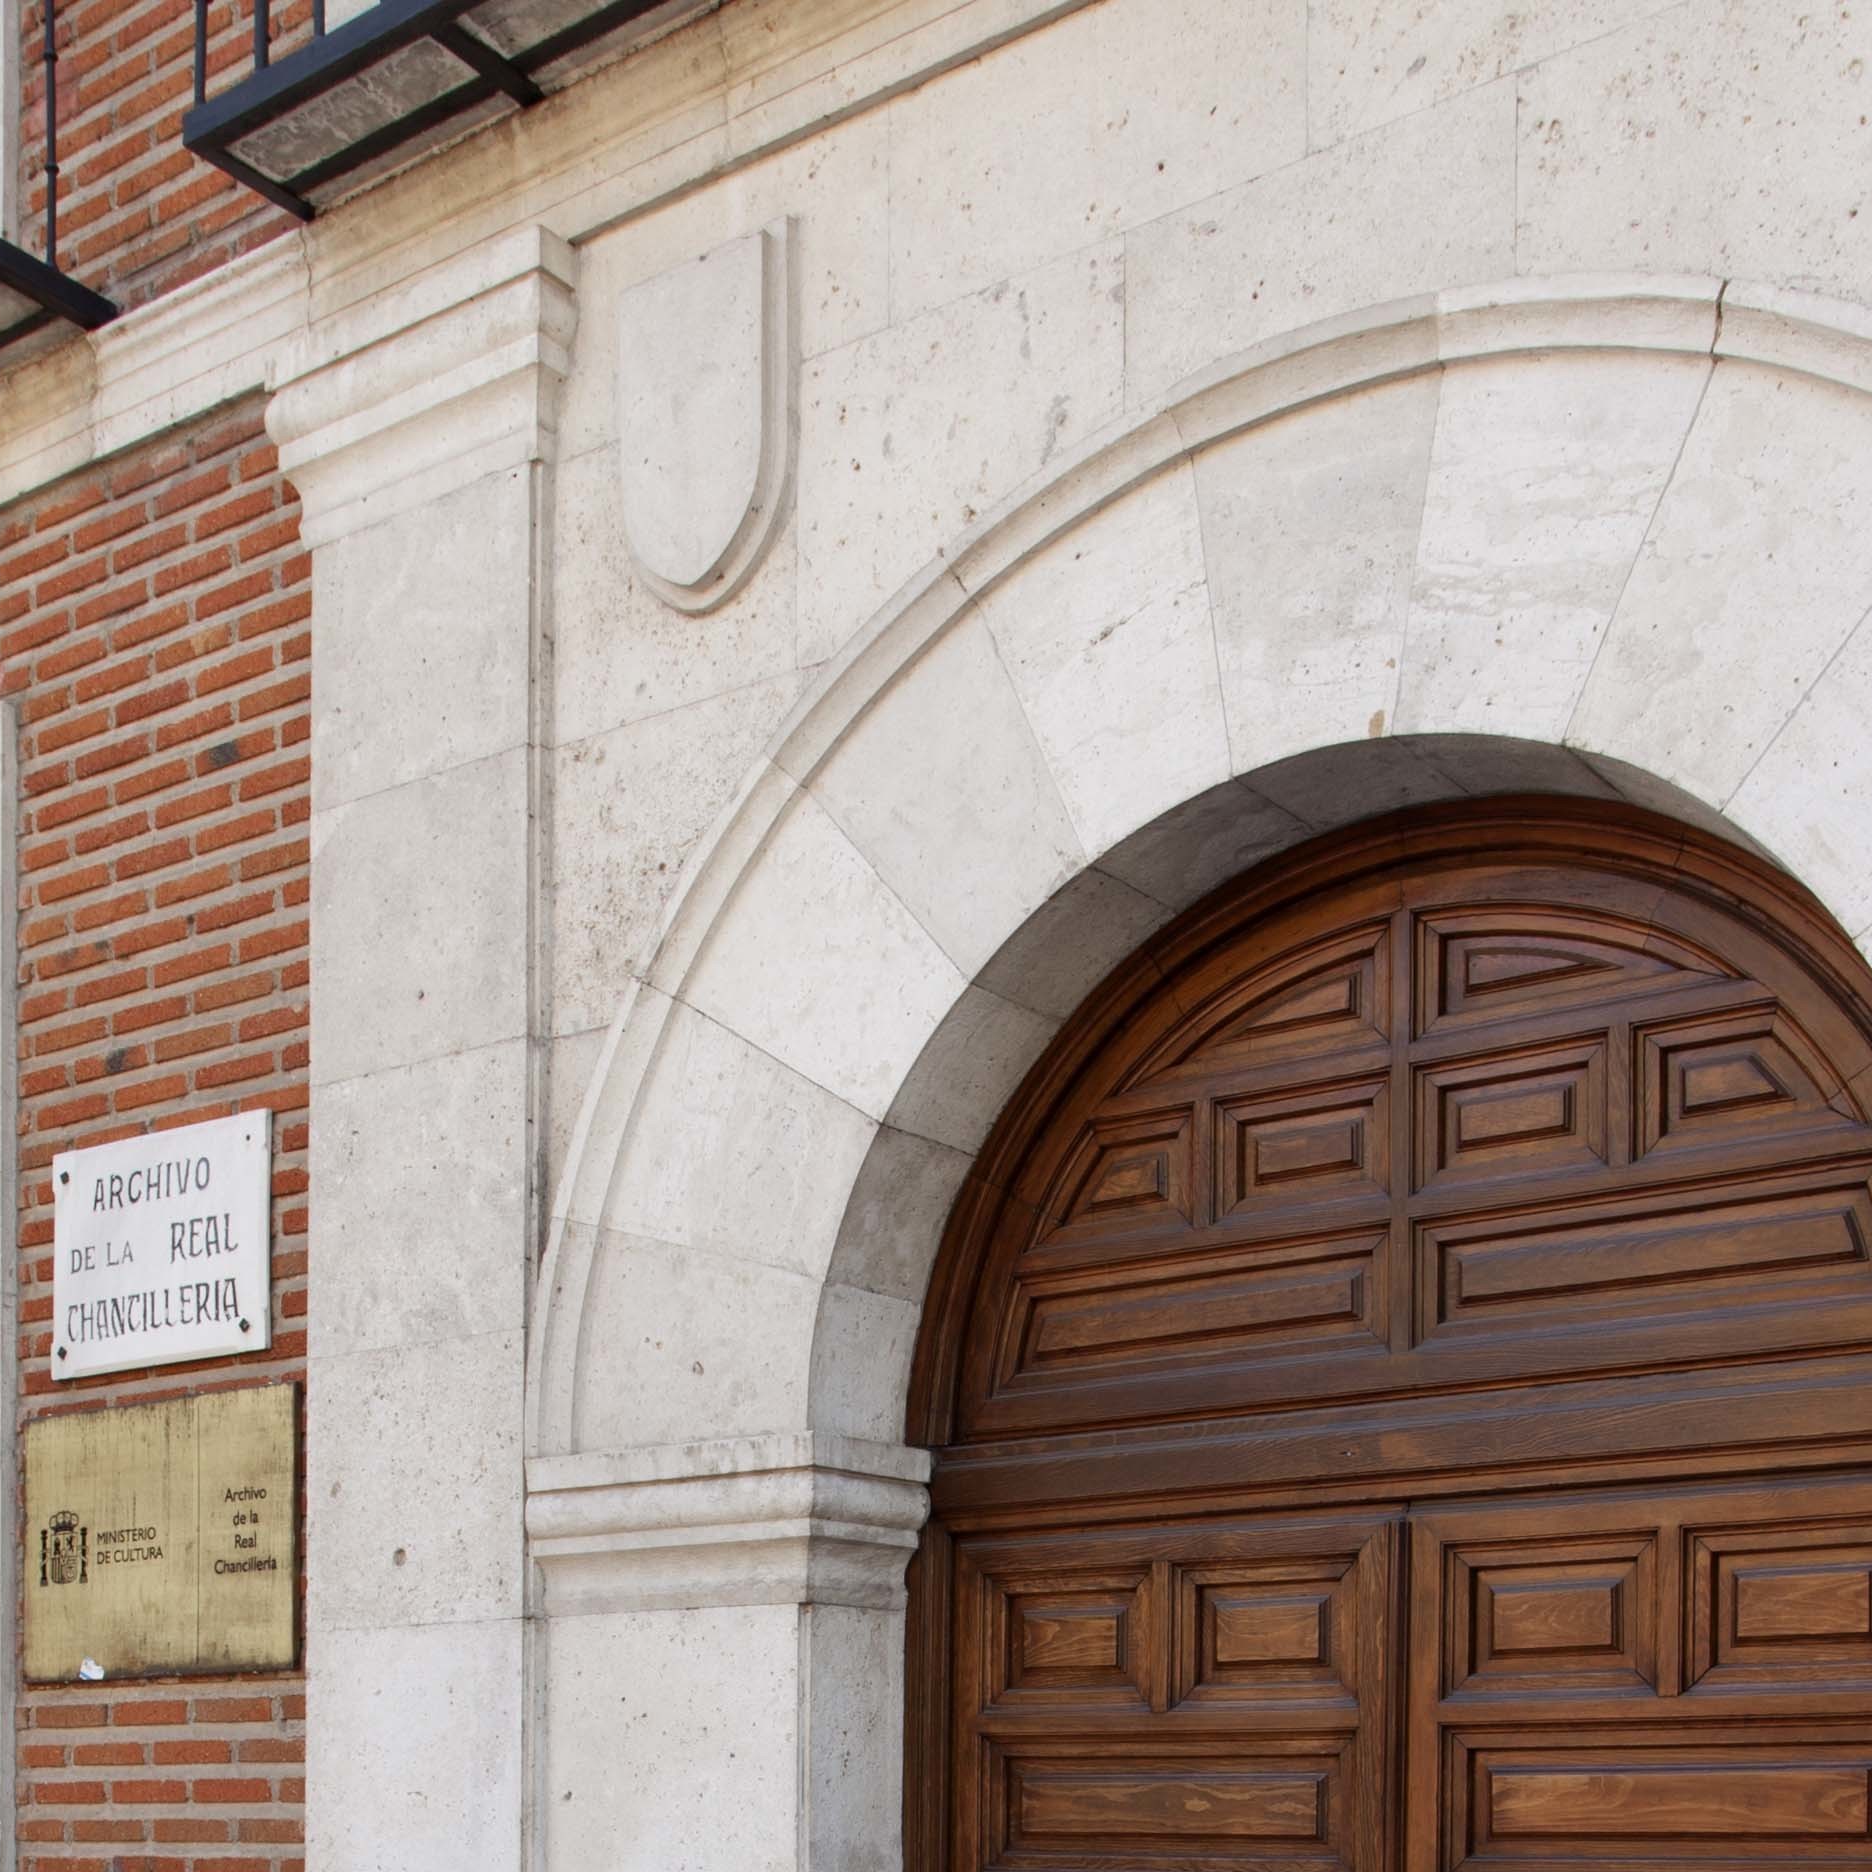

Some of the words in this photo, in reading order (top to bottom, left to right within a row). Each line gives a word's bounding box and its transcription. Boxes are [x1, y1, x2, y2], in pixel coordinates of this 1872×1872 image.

[93, 1157, 210, 1212] ARCHIVO
[70, 1246, 96, 1274] DE
[106, 1241, 134, 1268] LA
[170, 1213, 238, 1264] REAL
[68, 1278, 240, 1343] CHANCILLERIA
[224, 1486, 266, 1502] Archivo
[232, 1512, 246, 1526] de
[250, 1509, 258, 1524] la
[96, 1526, 156, 1545] MINISTERIO
[234, 1531, 257, 1549] Real
[96, 1551, 111, 1564] DE
[114, 1546, 164, 1564] CULTURA
